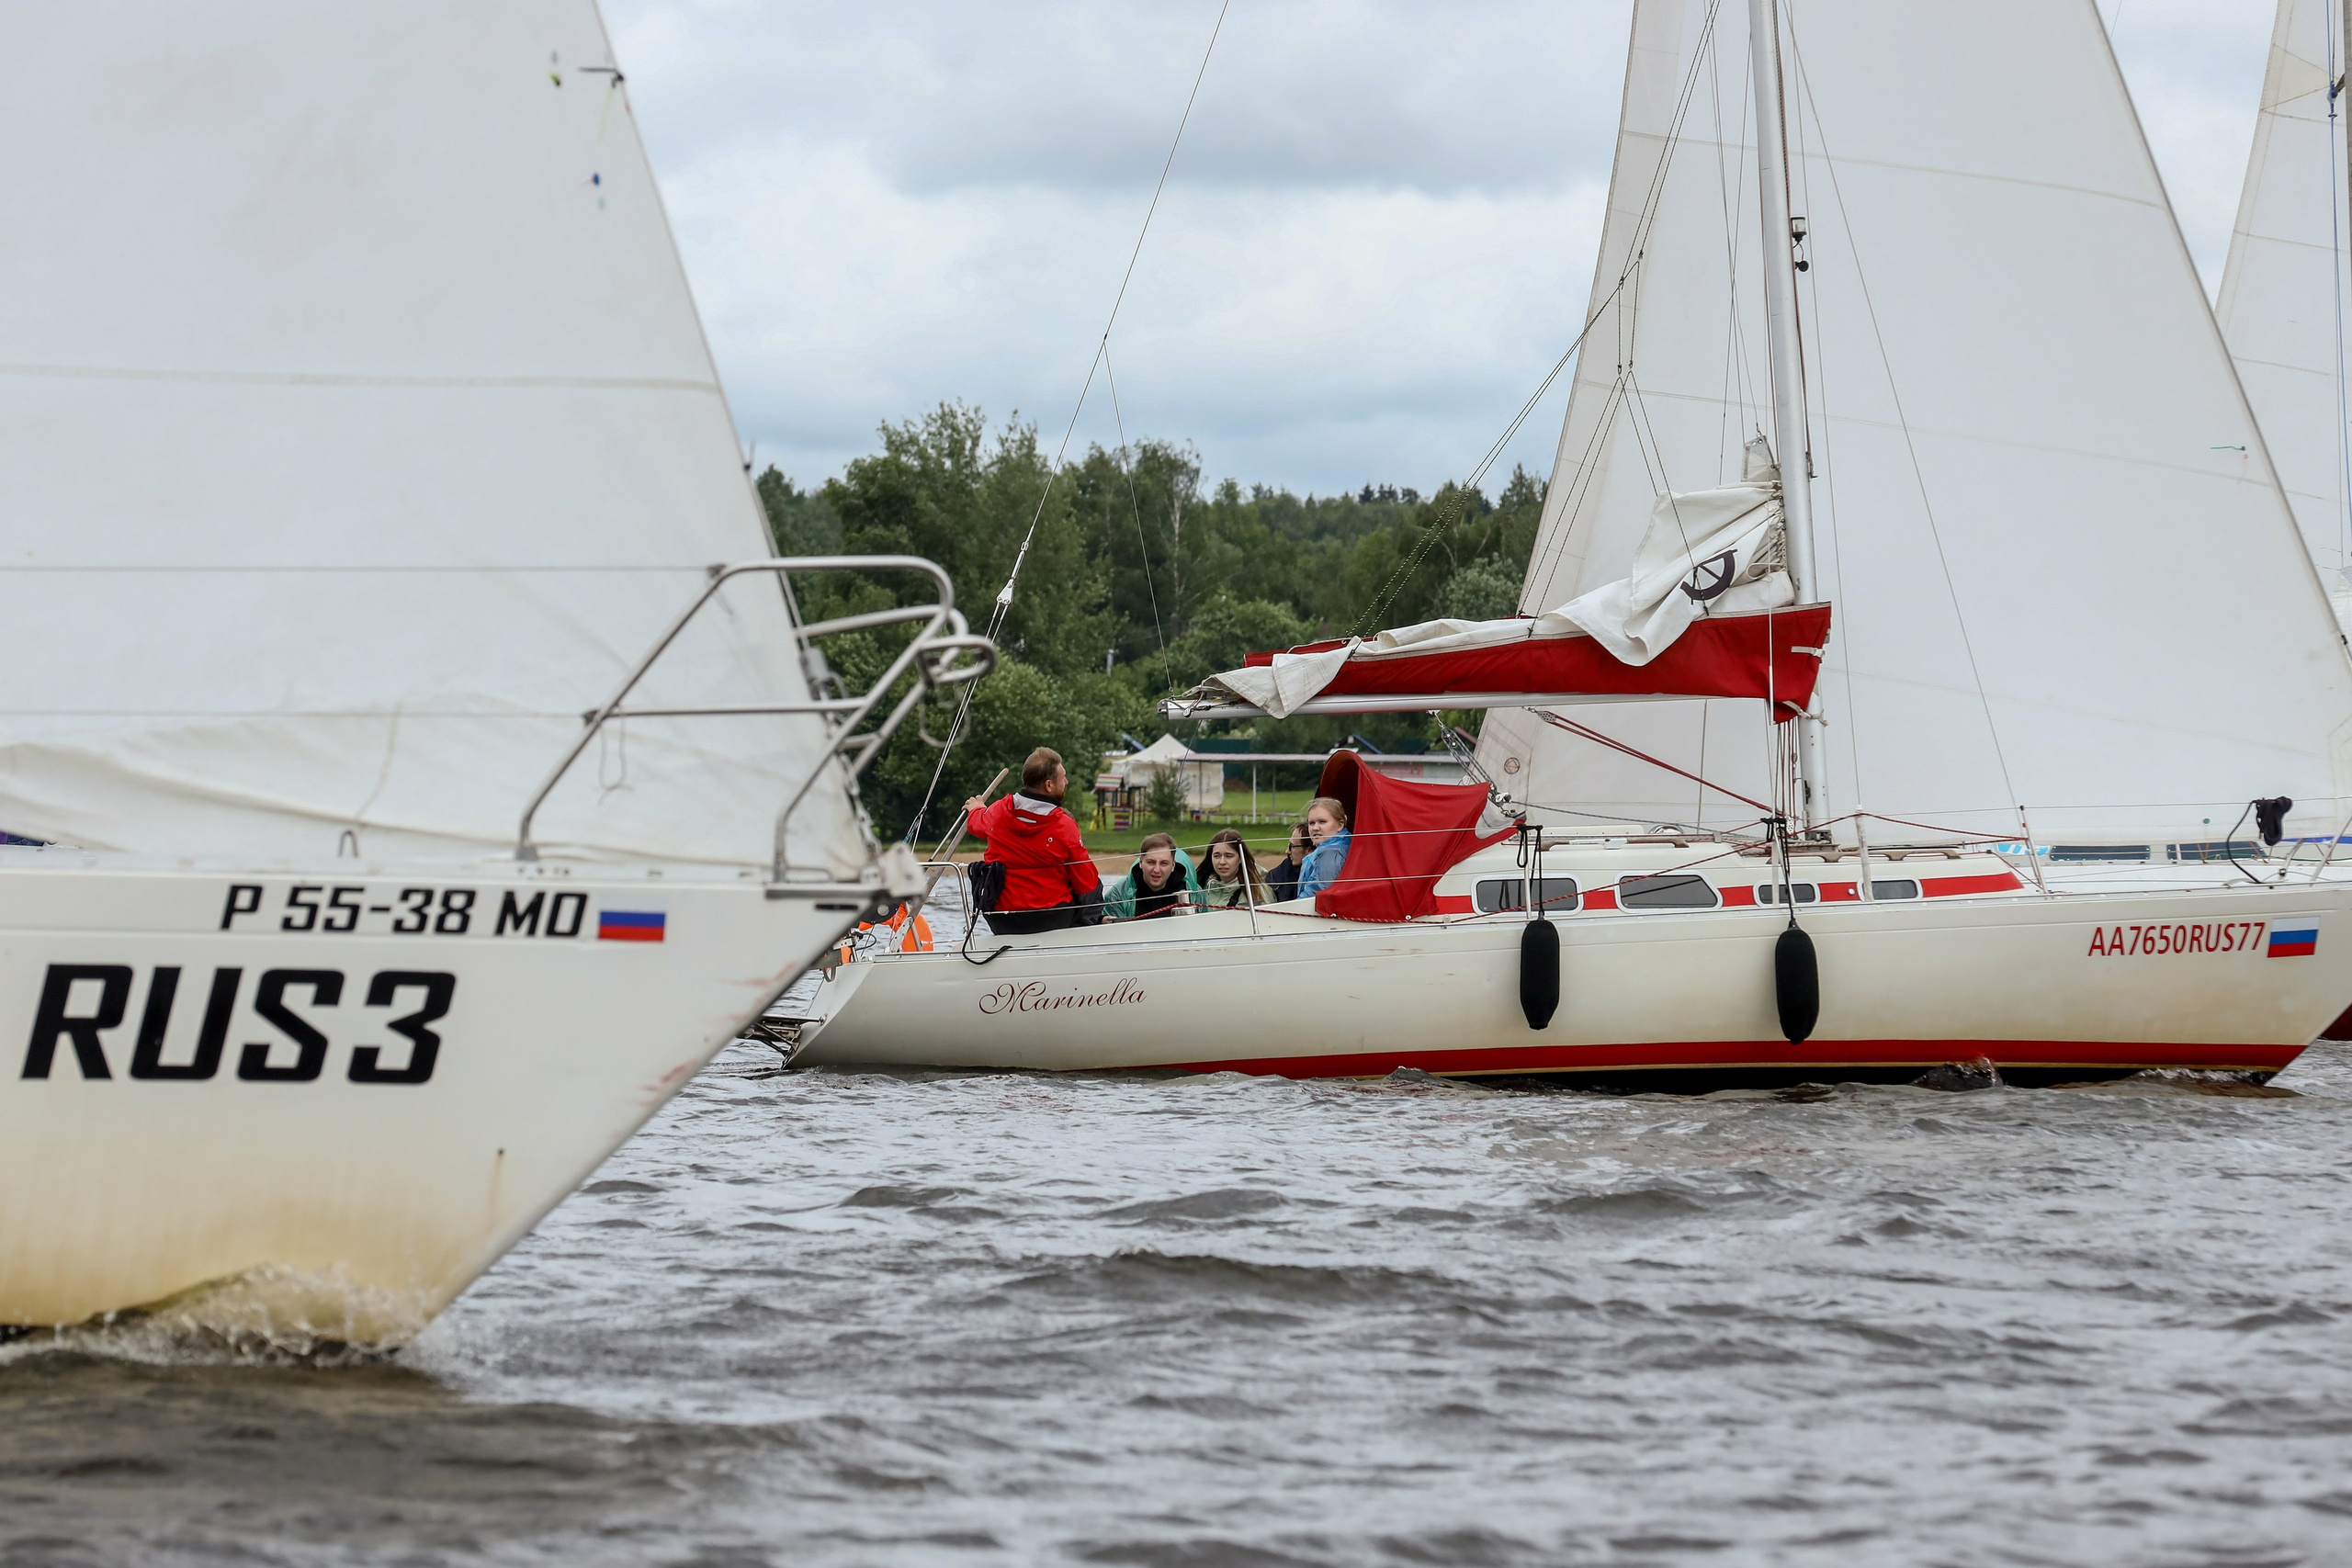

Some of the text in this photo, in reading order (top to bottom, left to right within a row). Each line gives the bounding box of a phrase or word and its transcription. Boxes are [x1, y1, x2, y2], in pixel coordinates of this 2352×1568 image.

[280, 886, 478, 936] 55-38
[2087, 921, 2267, 957] AA7650RUS77
[978, 976, 1148, 1015] Marinella
[20, 963, 458, 1085] RUS3
